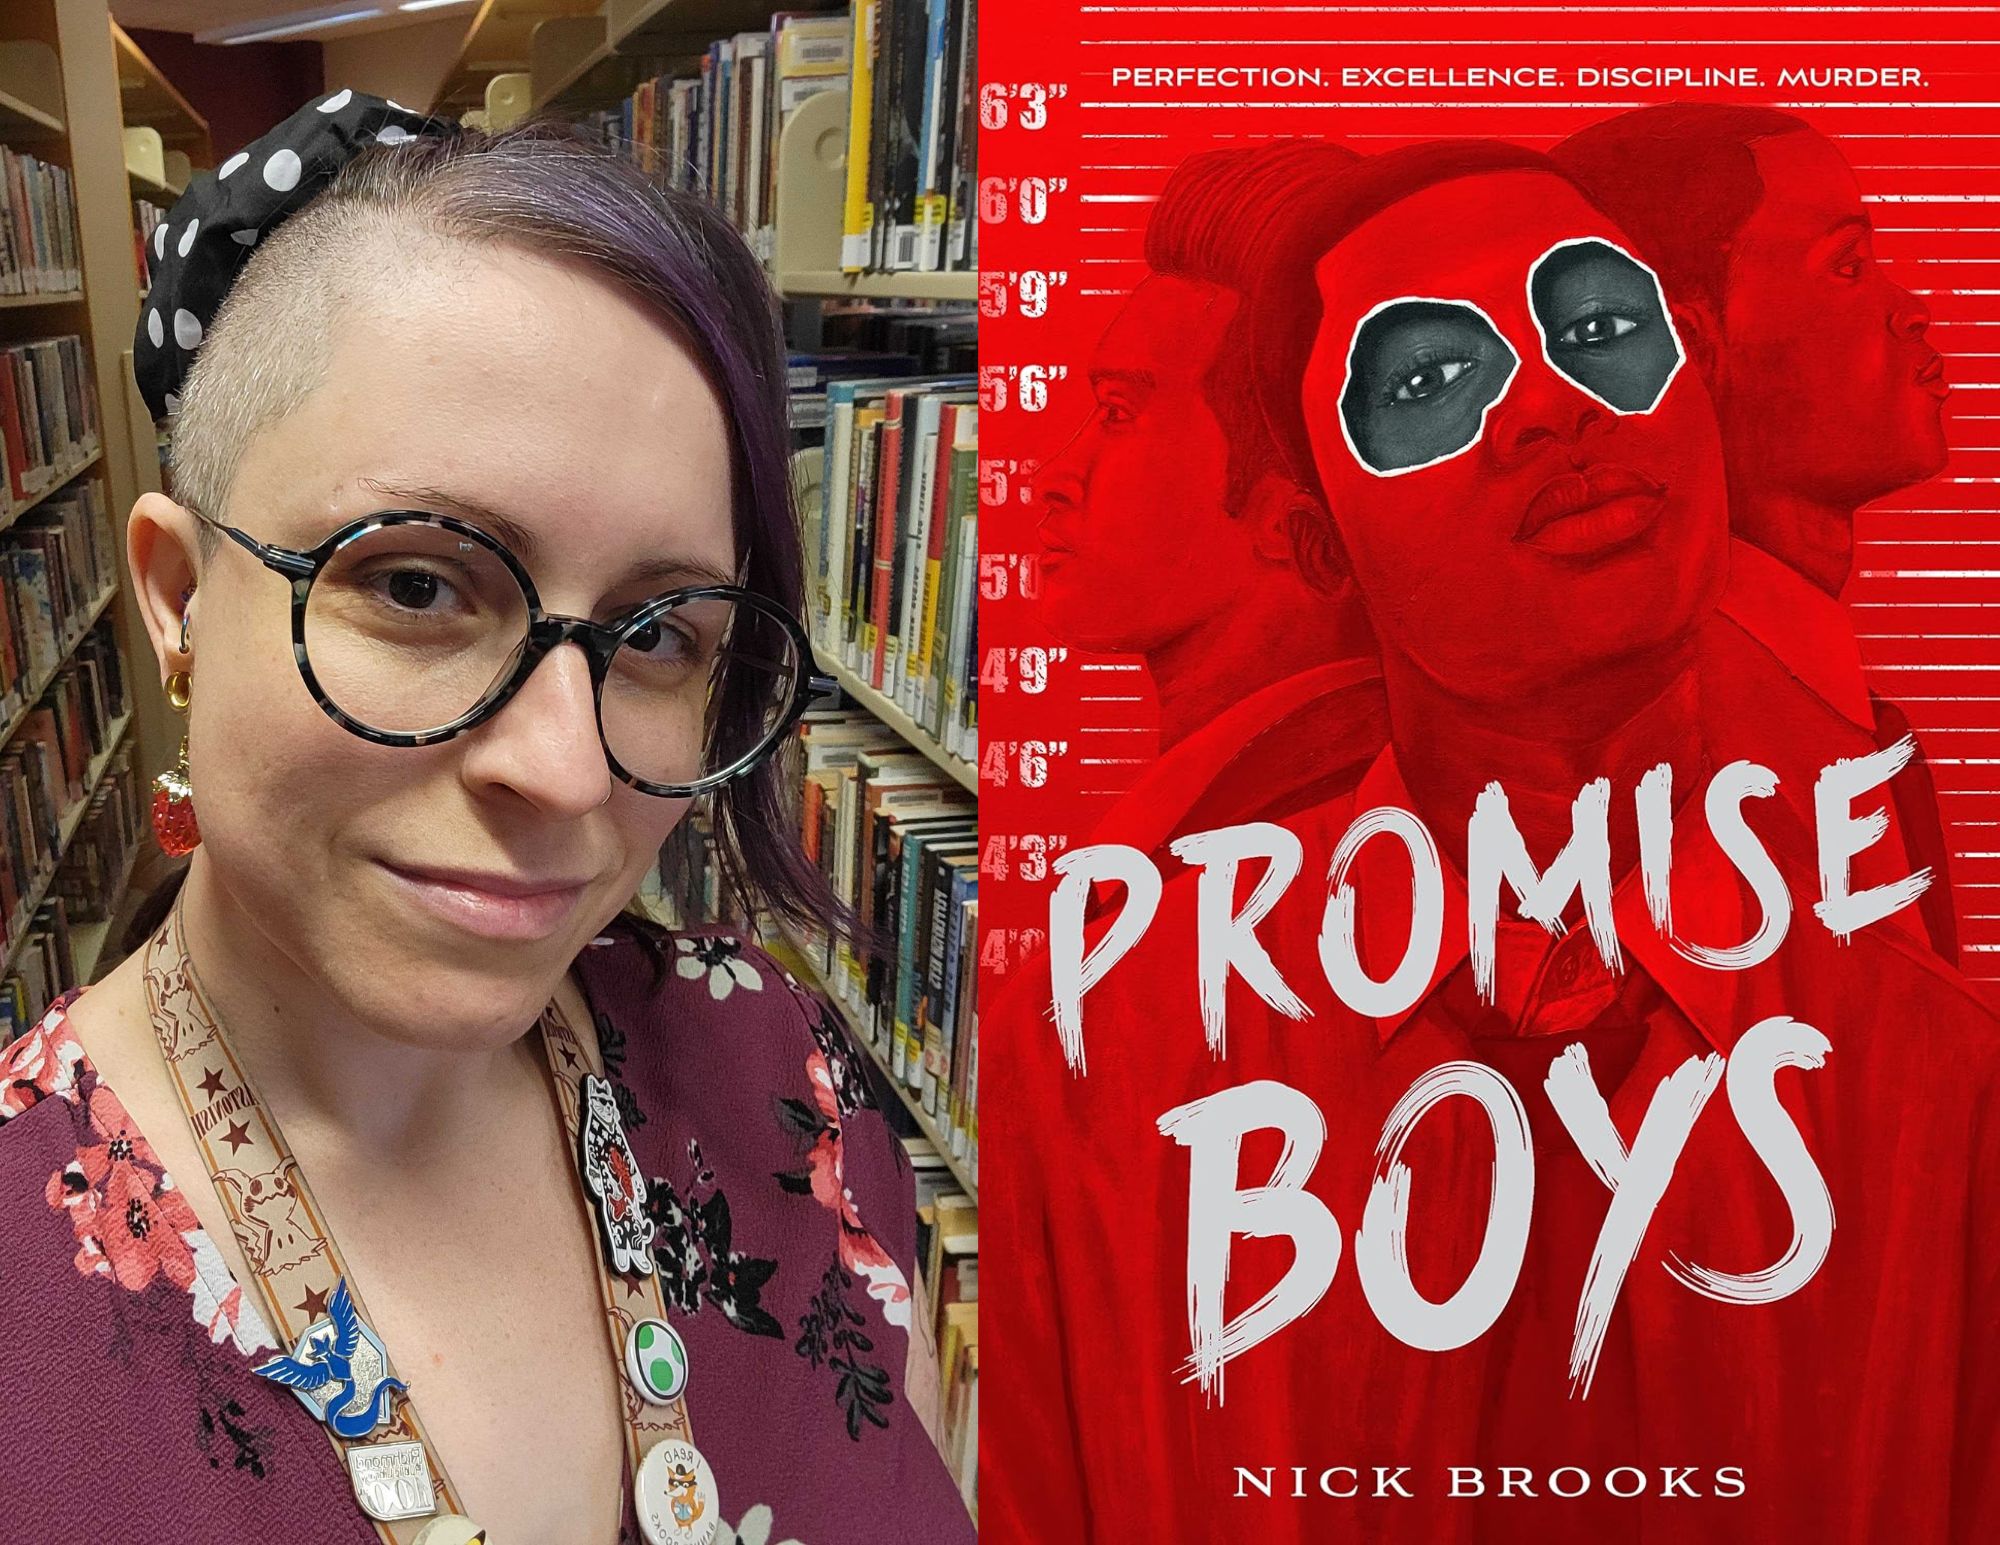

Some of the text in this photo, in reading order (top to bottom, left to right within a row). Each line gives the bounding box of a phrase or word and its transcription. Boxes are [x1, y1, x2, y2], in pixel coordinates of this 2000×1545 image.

[1112, 67, 1930, 88] PERFECTION. EXCELLENCE. DISCIPLINE. MURDER.
[1048, 733, 1936, 1078] PROMISE
[1156, 1015, 1837, 1408] BOYS
[1234, 1466, 1747, 1500] NICK BROOKS
